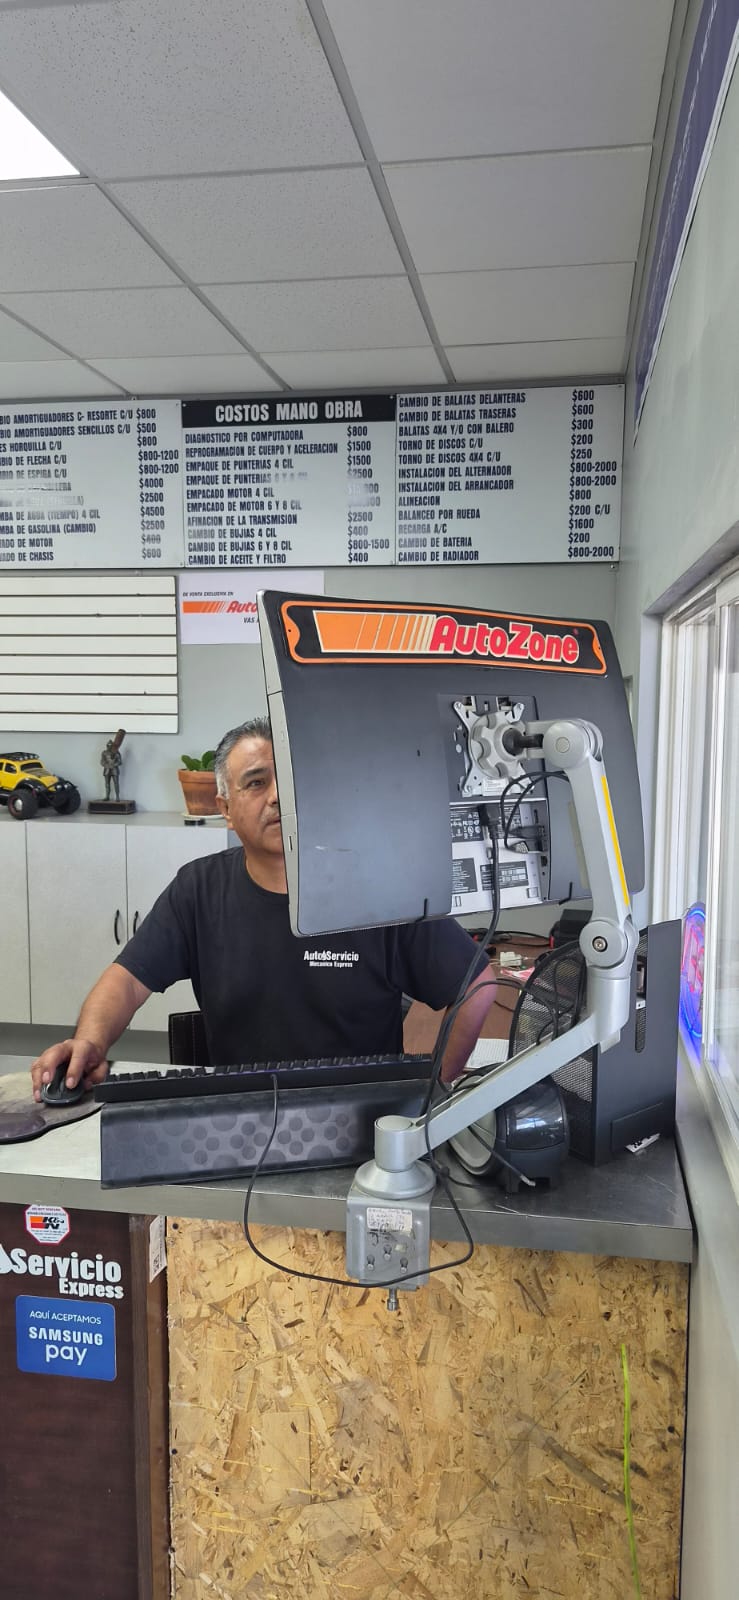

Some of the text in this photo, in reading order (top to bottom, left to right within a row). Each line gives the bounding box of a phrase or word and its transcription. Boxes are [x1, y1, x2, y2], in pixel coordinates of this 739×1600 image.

[399, 390, 594, 408] CAMBIO DE BALATAS DELANTERAS $600
[14, 409, 156, 424] AMORTIGUADORES RESORTE C/U $800
[215, 400, 363, 423] COSTOS MANO OBRA
[399, 405, 594, 422] CAMBIO DE BALATAS TRASERAS $600
[14, 423, 156, 438] AMORTIGUADORES SENCILLOS C/U $500
[185, 426, 368, 444] DIAGNOSTICO POR COMPUTADORA $800
[399, 419, 593, 437] BALATAS 4X4 Y/O CON BALERO $300
[10, 436, 157, 451] HORQUILLA C/U $800
[186, 441, 371, 458] REPROGRAMACION DE CUERPO ACELERACION $1500
[399, 434, 593, 451] TORNO DE DISCOS C/U $200
[16, 450, 179, 465] DE FLECHA C/U $800-1200
[186, 455, 371, 471] EMPAQUE DE PUNTERIAS CIL $1500
[399, 449, 592, 465] TORNO DE DISCOS 4X4 C/U $250
[54, 469, 67, 478] C/U
[139, 464, 179, 475] $800-1200
[399, 462, 617, 479] INSTALACION DEL ALTERNADOR $800-2000
[139, 478, 164, 488] $4000
[186, 475, 219, 485] EMPAQUE
[222, 474, 231, 484] DE
[234, 473, 272, 483] PUNTERIAS
[399, 475, 617, 493] INSTALACION DEL ARRANCADOR $800-2000
[140, 492, 164, 502] $2500
[186, 487, 252, 499] EMPACADO MOTOR
[398, 490, 591, 507] ALINEACION $800
[16, 511, 24, 520] DE
[140, 506, 165, 517] $4500
[187, 502, 225, 513] EMPACADO
[228, 502, 237, 511] DE
[240, 501, 265, 511] MOTOR
[398, 505, 610, 521] BALANCEO POR RUEDA $200 C/U
[17, 520, 165, 534] DE GASOLINA (CAMBIO) $2500
[187, 511, 373, 527] AFINACION DE LA TRANSMISION $2500
[398, 519, 594, 535] RECARGA A/C $1600
[188, 526, 368, 539] CAMBIO DE BUJIAS CIL $400
[398, 533, 590, 548] CAMBIO DE BATERIA $200
[18, 539, 26, 547] DE
[29, 538, 53, 547] MOTOR
[188, 539, 390, 552] CAMBIO DE BUJIAS CIL $800-1500
[18, 552, 54, 561] DE CHASIS
[188, 552, 368, 565] CAMBIO DE ACEITE FILTRO $400
[398, 546, 614, 562] CAMBIO DE RADIADOR $800-2000
[429, 616, 580, 664] AutoZone
[326, 951, 359, 961] Servicio
[10, 1248, 122, 1283] Servicio
[59, 1278, 124, 1299] Express
[30, 1311, 101, 1324] AQUÍ ACEPTAMOS
[29, 1327, 103, 1346] SAMSUNG
[46, 1344, 87, 1365] pay
